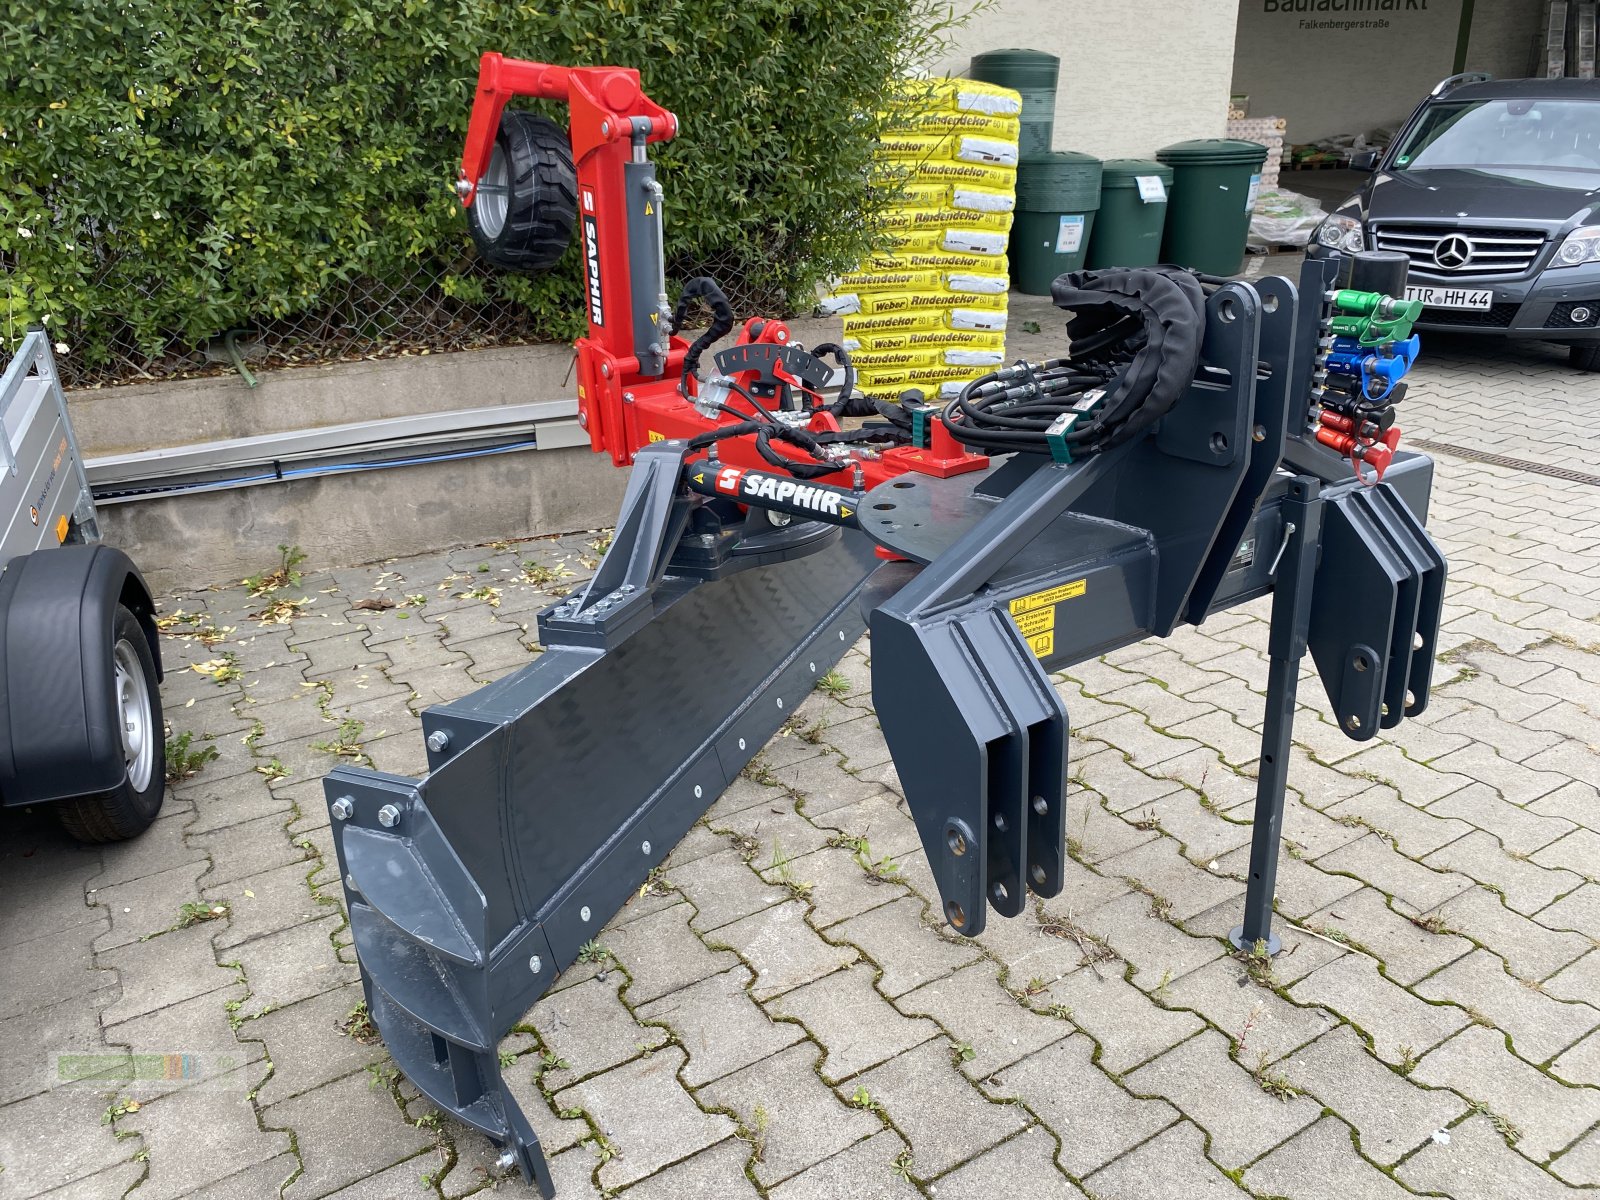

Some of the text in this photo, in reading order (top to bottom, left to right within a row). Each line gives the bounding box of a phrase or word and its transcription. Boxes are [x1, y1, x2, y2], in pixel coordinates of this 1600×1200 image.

[1299, 19, 1390, 31] Falkenbergerstraße
[919, 164, 989, 177] Rindendekor
[914, 210, 985, 222] Rindendekor
[910, 256, 979, 266] Rindendekor
[586, 221, 602, 326] SAPHIR
[842, 274, 913, 285] Rindendekor
[876, 302, 905, 311] Weber
[911, 295, 978, 305] Rindendekor
[1406, 288, 1489, 306] TIR HH 44
[846, 317, 917, 331] Rindendekor
[875, 340, 903, 348] Weber
[910, 332, 976, 343] Rindendekor
[874, 376, 903, 385] Weber
[908, 367, 974, 380] Rindendekor
[744, 475, 841, 515] SAPHIR
